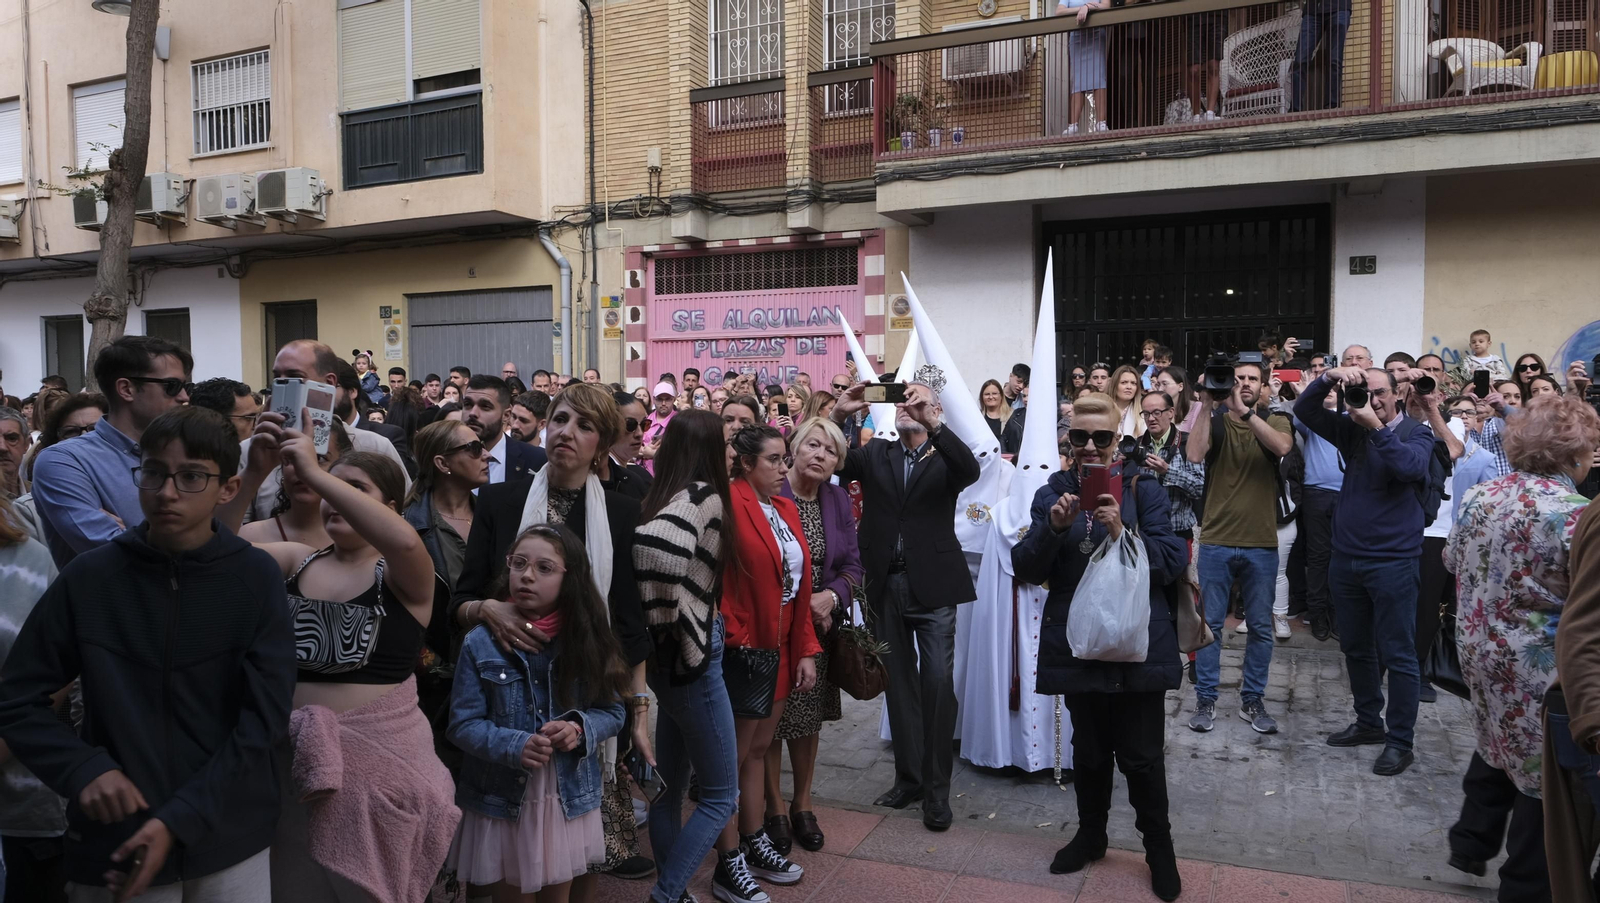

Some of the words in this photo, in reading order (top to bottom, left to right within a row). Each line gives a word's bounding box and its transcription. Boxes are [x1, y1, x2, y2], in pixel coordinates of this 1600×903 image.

[1351, 257, 1375, 273] 45
[672, 309, 705, 332] SE
[722, 305, 841, 331] ALQUILAN
[694, 337, 787, 359] PLAZAS
[796, 337, 828, 356] DE
[704, 365, 799, 386] GAJE
